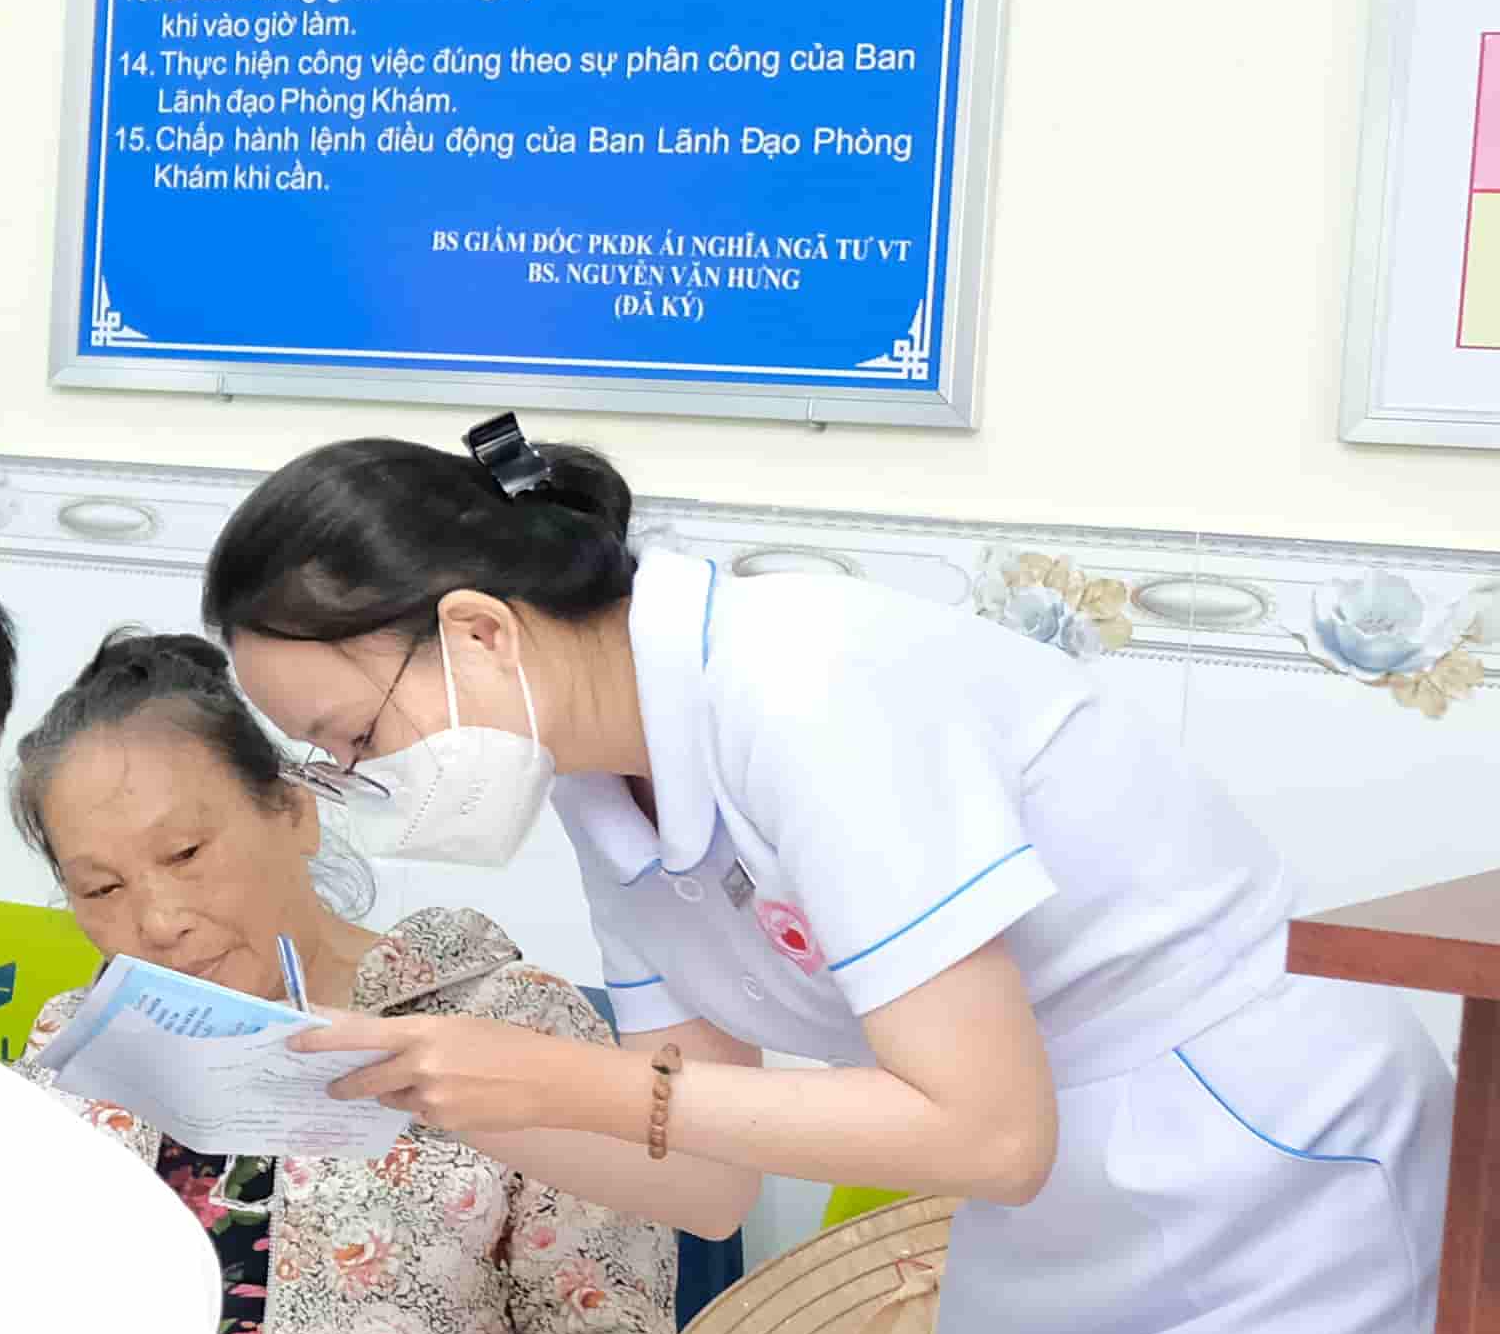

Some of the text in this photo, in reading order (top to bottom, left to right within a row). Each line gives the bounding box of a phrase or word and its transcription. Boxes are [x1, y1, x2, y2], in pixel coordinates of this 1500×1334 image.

[430, 223, 914, 263] BS GIÁM ĐỐC PKĐK ÁI NGHĨA NGÃ TƯ VT
[526, 258, 801, 291] BS. NGUYỄN VĂN HƯNG
[612, 288, 705, 323] (ĐÃ KÝ)
